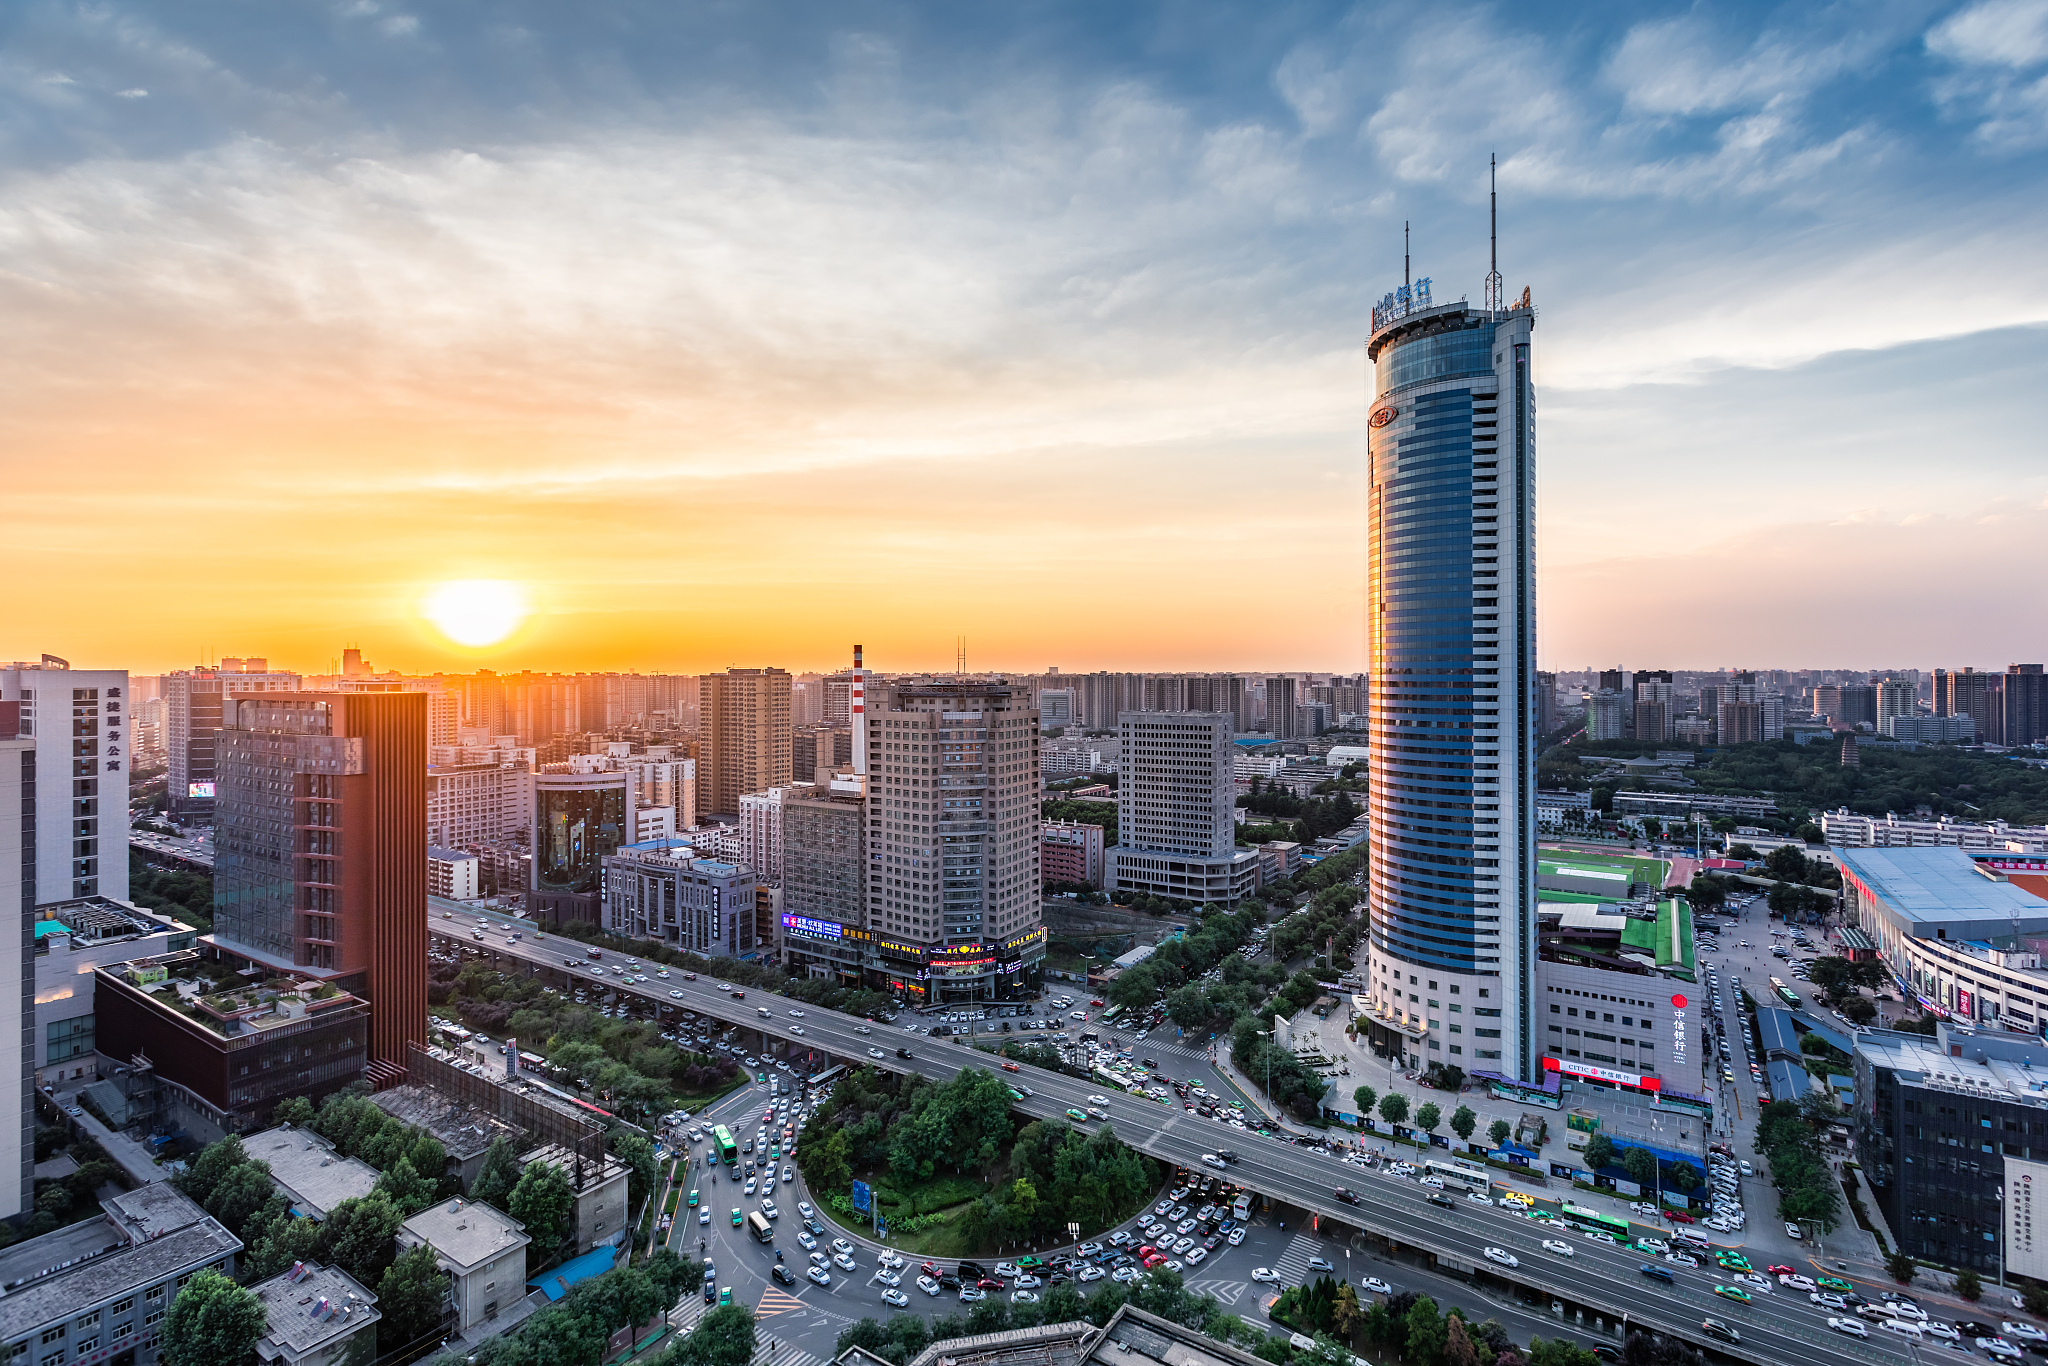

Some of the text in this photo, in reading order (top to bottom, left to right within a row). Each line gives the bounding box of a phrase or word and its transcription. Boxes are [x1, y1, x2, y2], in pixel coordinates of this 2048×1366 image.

[106, 687, 121, 771] 盛捷服务公寓
[1673, 1009, 1687, 1051] 中信银行
[1568, 1064, 1589, 1073] CITIC
[1600, 1070, 1630, 1082] 中信银行
